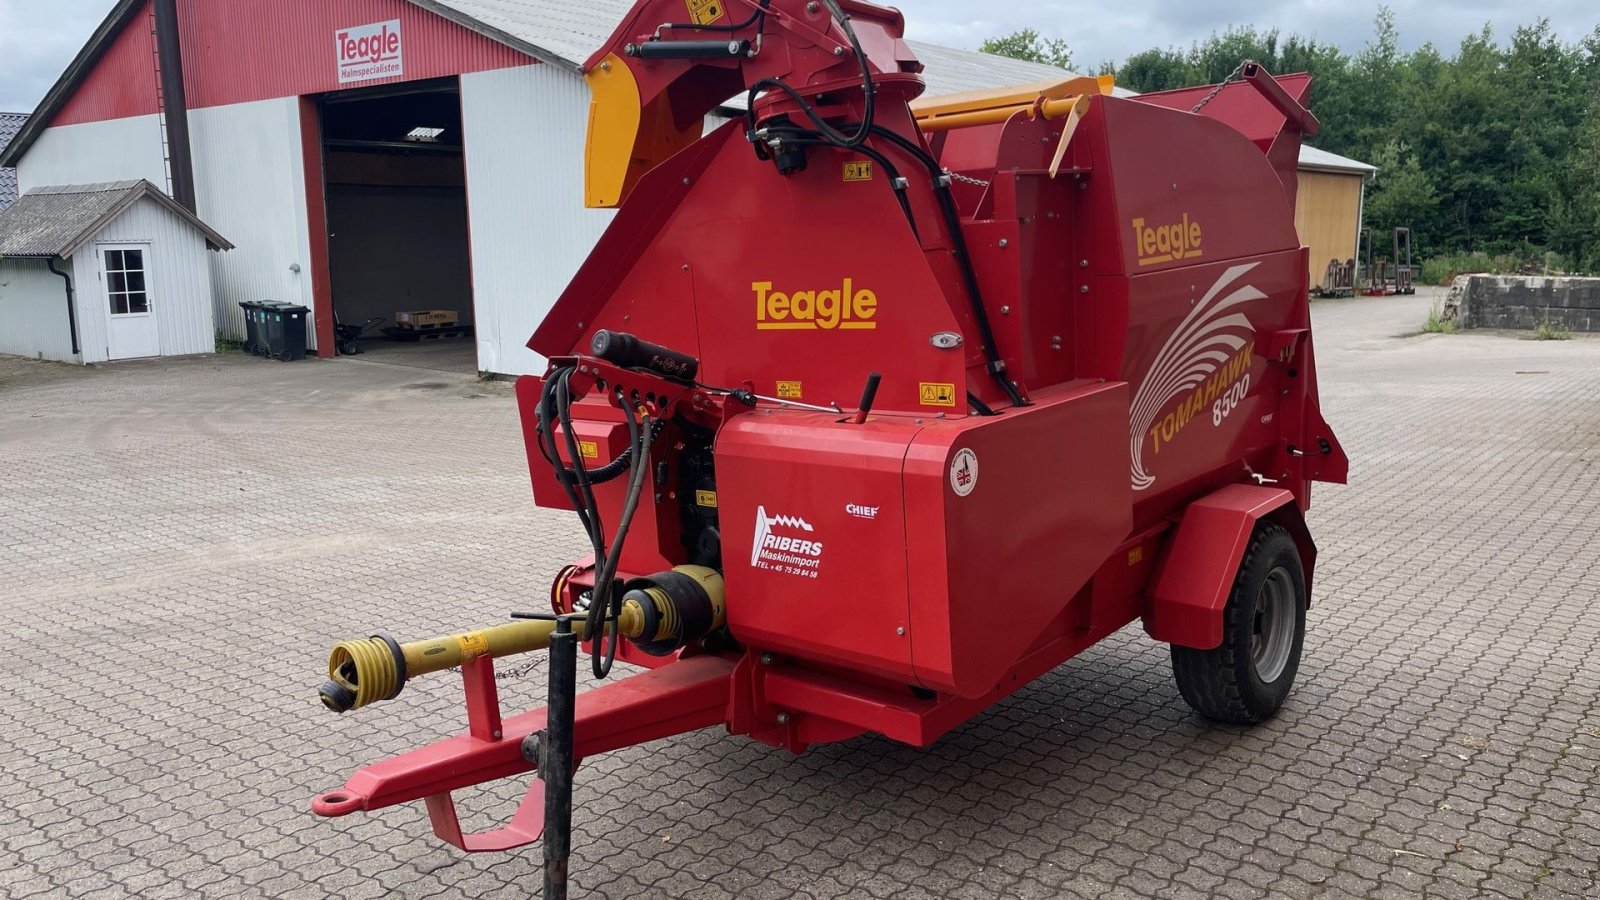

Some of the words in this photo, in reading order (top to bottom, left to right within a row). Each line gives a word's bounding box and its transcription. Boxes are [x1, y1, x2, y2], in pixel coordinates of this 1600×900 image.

[338, 24, 399, 63] Teagle
[341, 63, 400, 78] Halmspecialisten
[1132, 212, 1202, 259] Teagle
[752, 278, 877, 329] Teagle
[1150, 341, 1255, 455] TOMAHAWK
[1213, 373, 1250, 427] 8500
[846, 502, 880, 517] CHIEF
[760, 549, 820, 568] Maskinimport
[764, 534, 823, 556] RIBERS
[757, 561, 769, 569] TEL
[784, 566, 792, 574] 75
